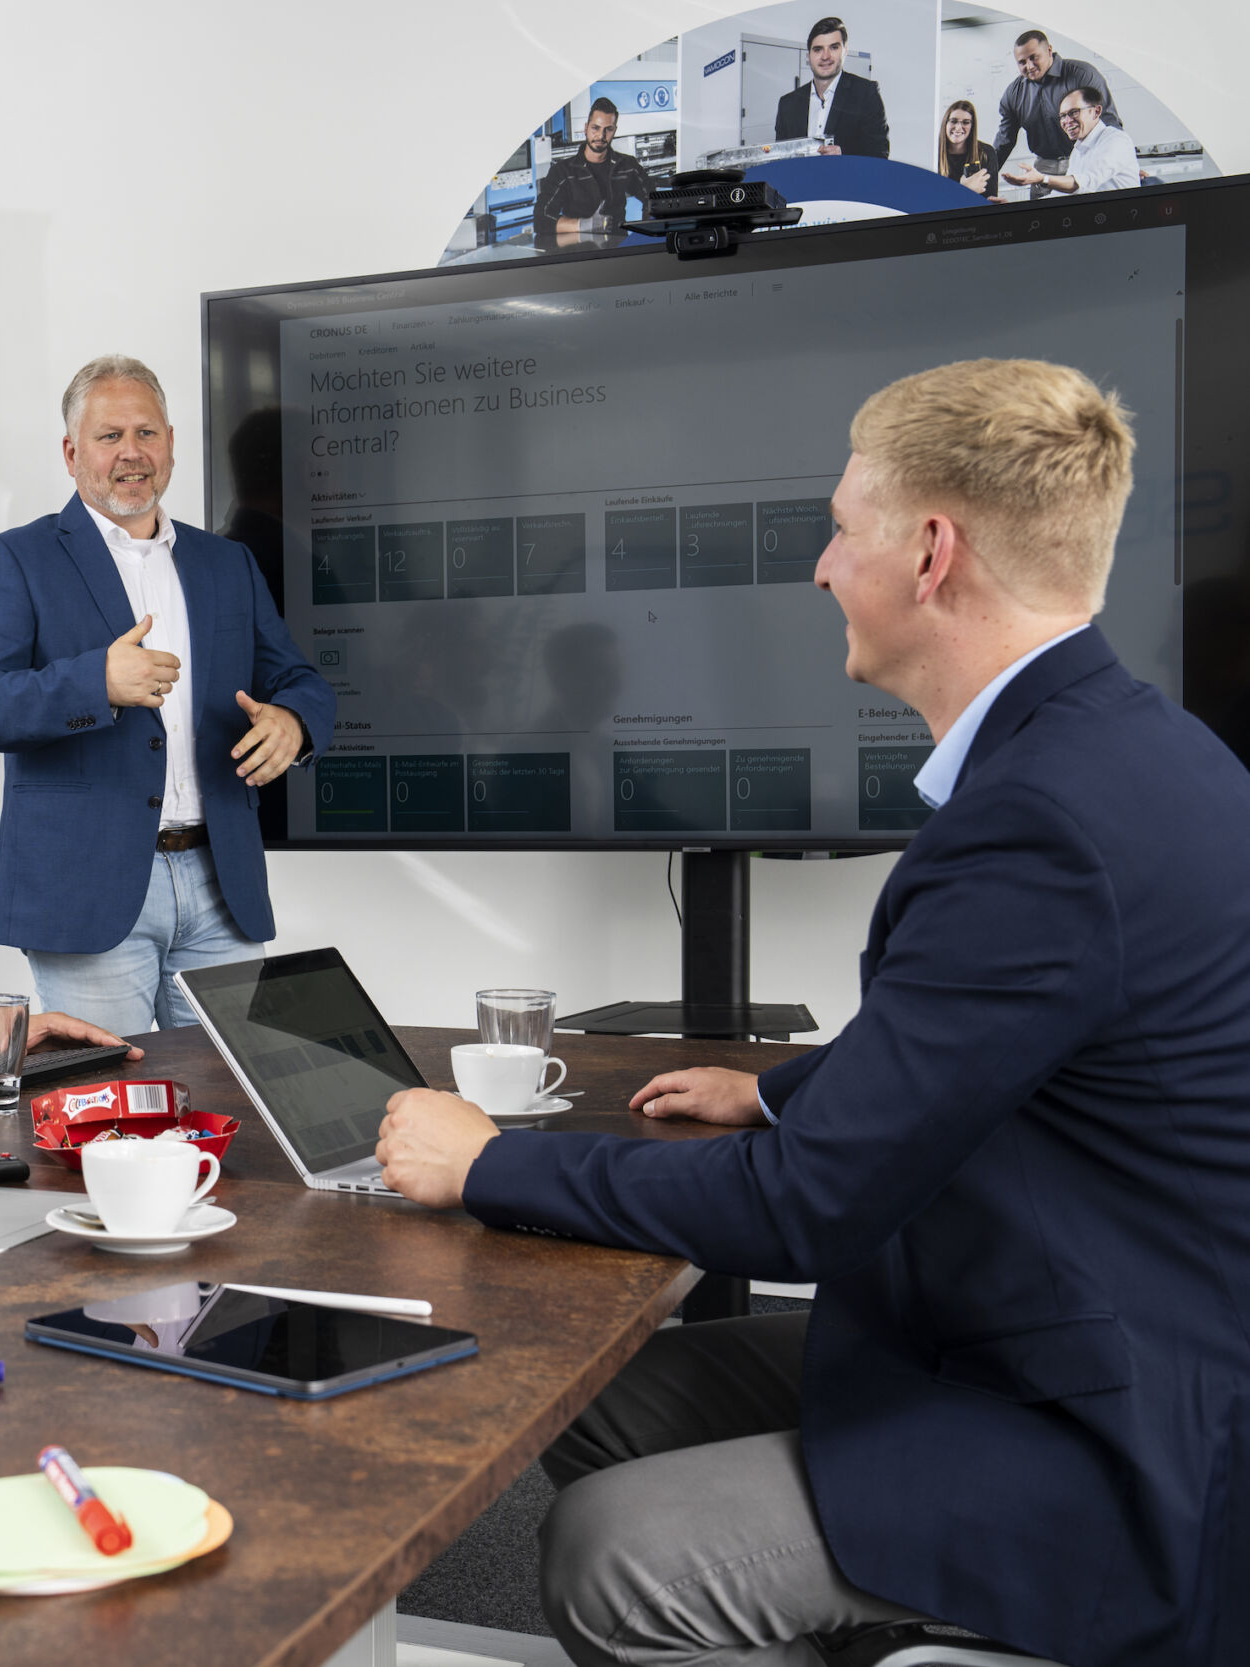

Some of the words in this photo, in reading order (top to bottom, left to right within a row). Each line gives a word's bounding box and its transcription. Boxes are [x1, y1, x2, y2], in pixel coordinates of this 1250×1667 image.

[683, 291, 701, 302] Alle
[702, 287, 738, 301] Berichte
[391, 320, 427, 330] Finanzen
[614, 297, 646, 308] Einkauf
[309, 327, 352, 339] CRONUS
[354, 325, 368, 335] DE
[309, 350, 347, 361] Debitoren
[358, 345, 399, 356] Kreditoren
[410, 341, 437, 352] Artikel
[309, 367, 407, 394] Möchten
[414, 361, 447, 385] Sie
[453, 356, 537, 380] weitere
[310, 392, 467, 426] Informationen
[473, 392, 501, 413] zu
[508, 382, 607, 411] Business
[310, 430, 400, 458] Central?
[310, 491, 358, 503] Aktivitäten
[605, 496, 640, 506] Laufende
[640, 494, 674, 504] Einkäufe
[310, 514, 346, 525] Laufender
[346, 512, 373, 522] Verkauf
[611, 538, 627, 561] 4
[685, 533, 700, 557] 3
[763, 529, 778, 553] 0
[317, 554, 331, 575] 4
[384, 550, 407, 573] 12
[452, 546, 467, 569] 0
[523, 543, 537, 566] 7
[312, 626, 336, 636] Belege
[336, 625, 365, 635] scannen
[613, 712, 693, 725] Genehmigungen
[614, 737, 661, 747] Ausstehende
[662, 736, 726, 747] Genehmigungen
[858, 733, 909, 743] Eingehender
[619, 756, 674, 767] Anforderungen
[747, 753, 805, 765] genehmigende
[864, 752, 908, 762] Verknüpfte
[864, 761, 916, 771] Bestellungen
[512, 767, 536, 776] letzten
[632, 765, 685, 776] Genehmigung
[735, 764, 793, 775] Anforderungen
[321, 782, 334, 804] 0
[396, 781, 409, 804] 0
[473, 780, 487, 803] 0
[619, 778, 634, 801] 0
[736, 776, 751, 800] 0
[865, 774, 880, 798] 0
